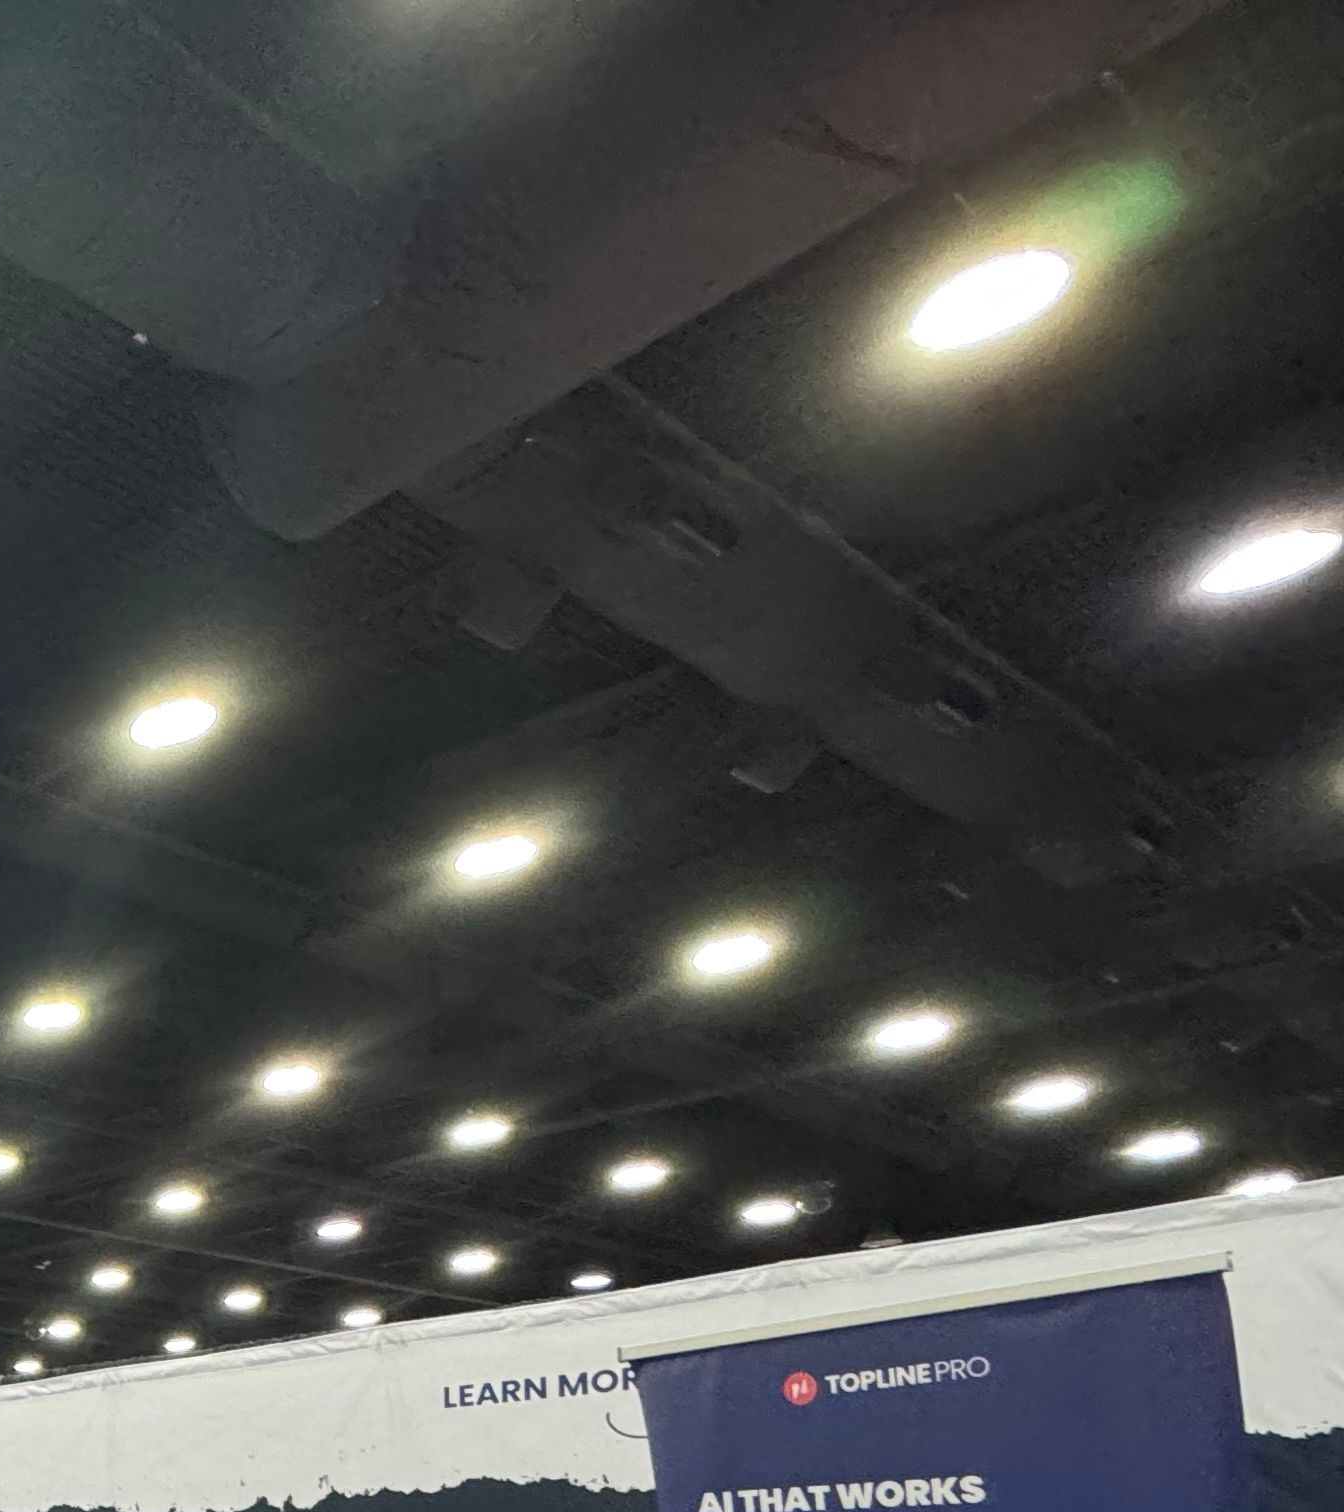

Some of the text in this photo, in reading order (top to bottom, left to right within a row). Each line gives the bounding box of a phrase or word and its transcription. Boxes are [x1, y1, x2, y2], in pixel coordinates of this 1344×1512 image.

[444, 1369, 637, 1409] LEARN MOR
[836, 1475, 986, 1510] WORKS
